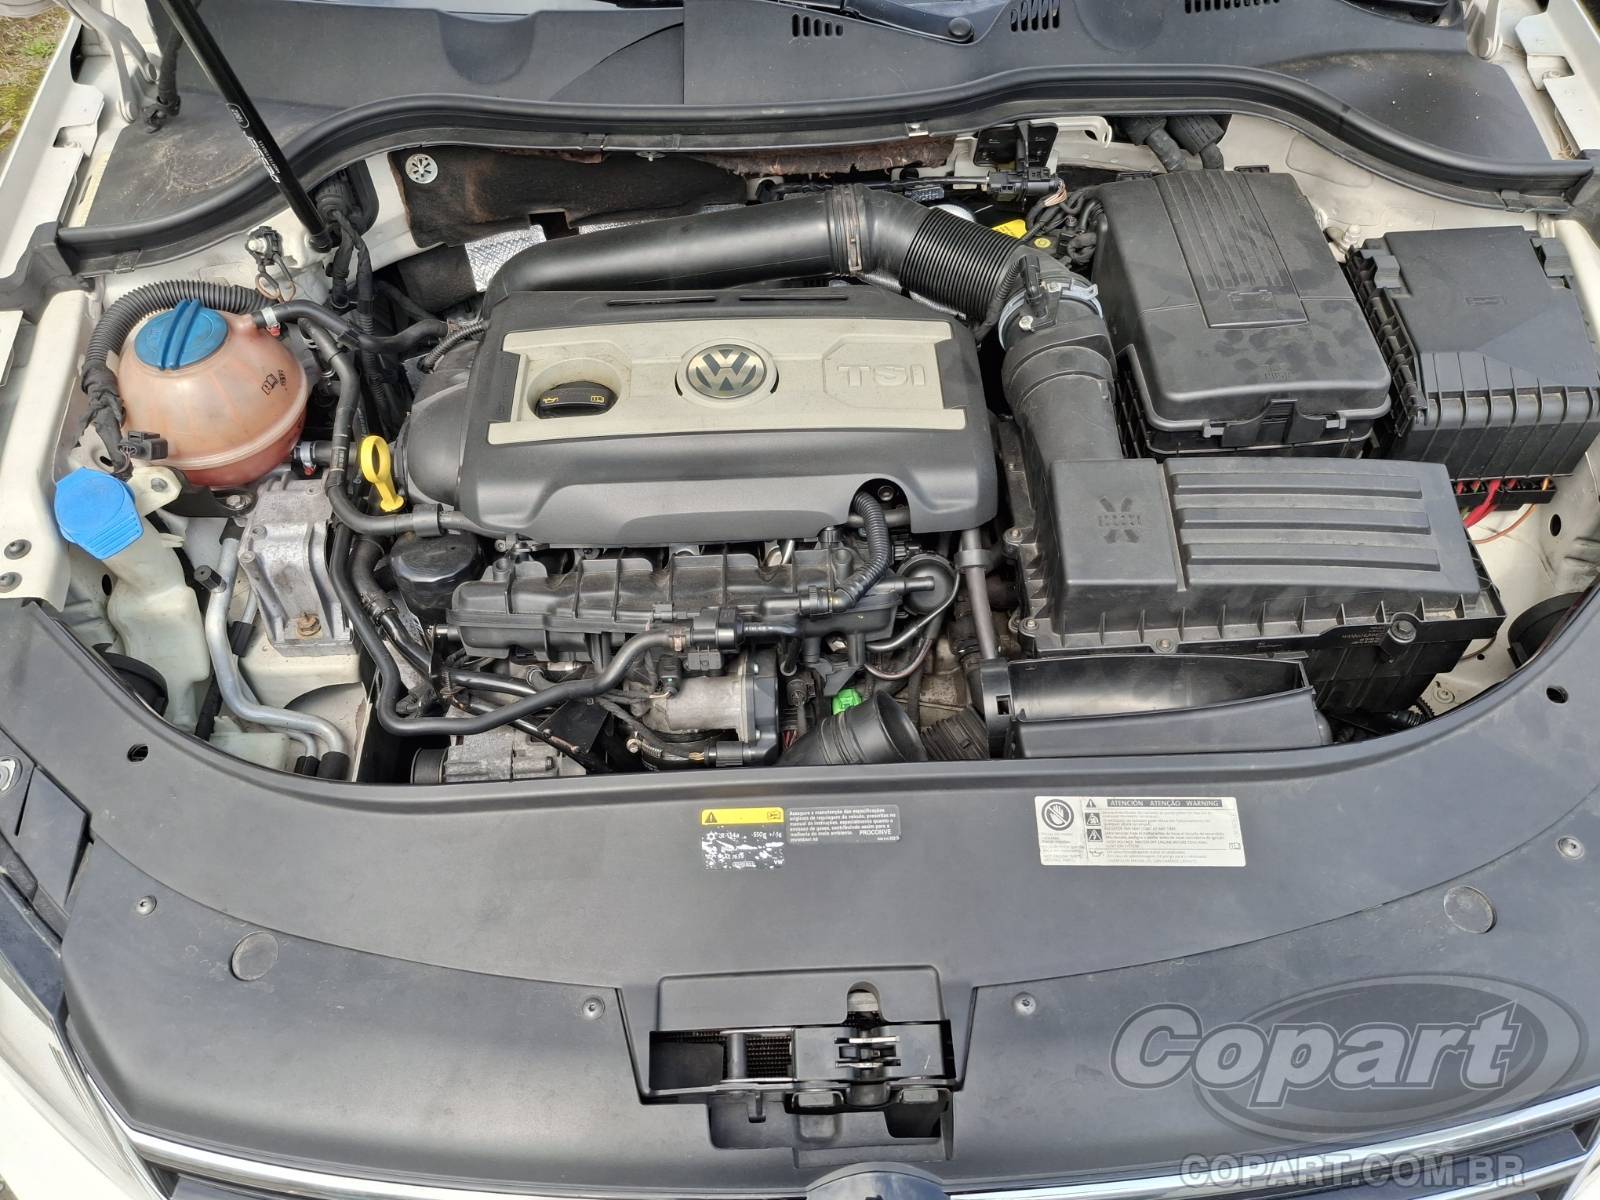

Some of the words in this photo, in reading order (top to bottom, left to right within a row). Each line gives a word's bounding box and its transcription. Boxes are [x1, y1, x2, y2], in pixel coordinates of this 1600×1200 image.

[837, 363, 925, 387] TSI
[1110, 799, 1144, 807] ATENCIÓN
[1150, 799, 1181, 808] ATENÇÃO
[1186, 799, 1219, 807] WARNING
